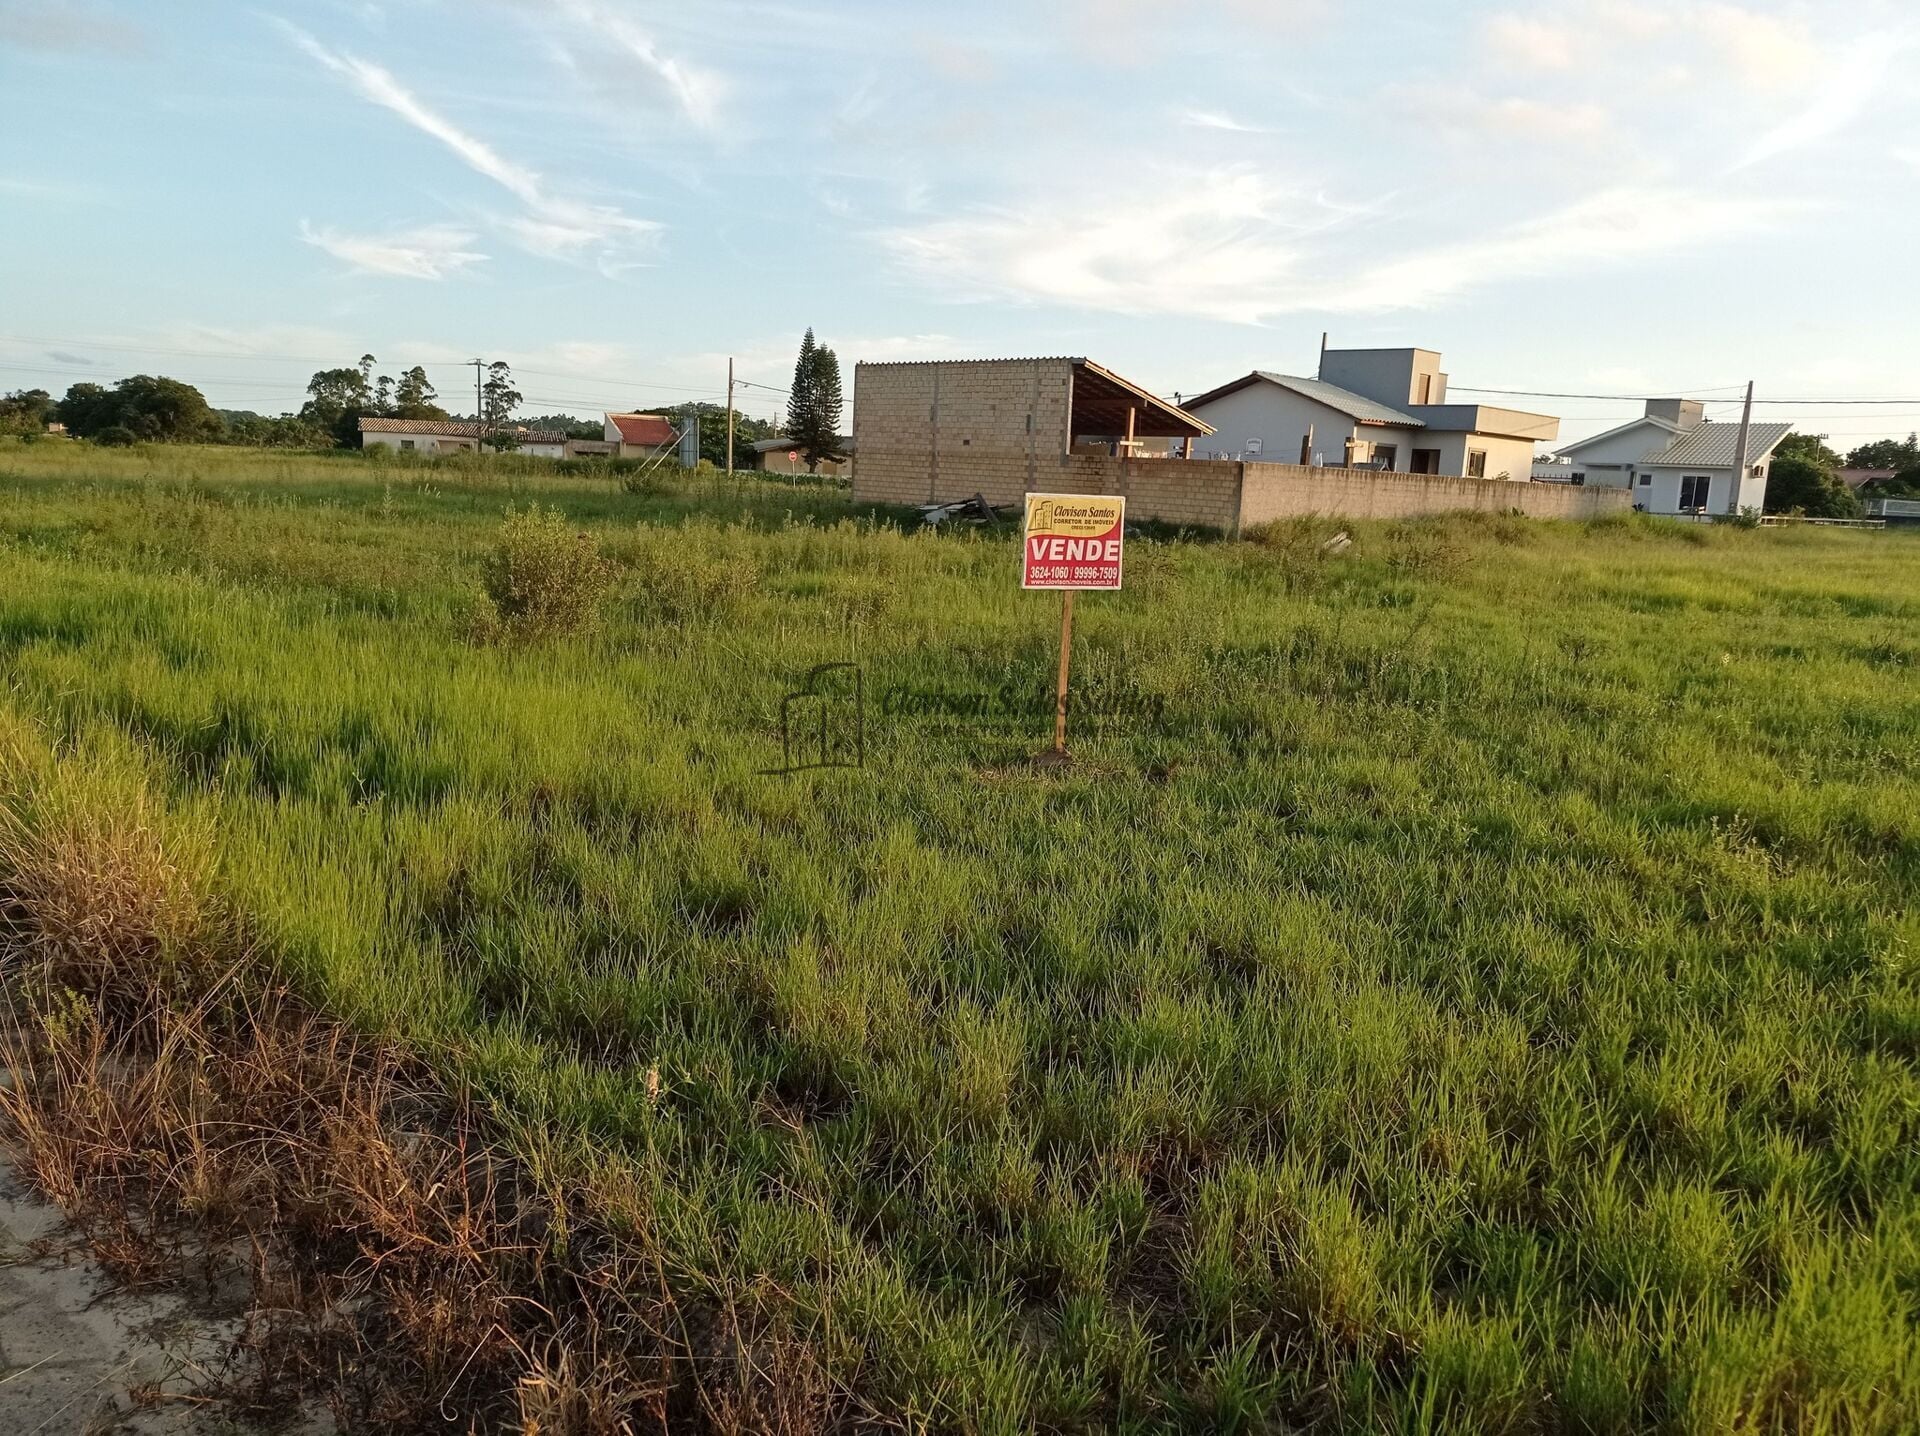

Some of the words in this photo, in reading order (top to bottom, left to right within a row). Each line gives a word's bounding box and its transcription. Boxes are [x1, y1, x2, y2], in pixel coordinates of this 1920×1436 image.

[1054, 505, 1087, 517] Clovison
[1088, 506, 1115, 518] Santos
[1031, 538, 1120, 562] VENDE
[1030, 566, 1069, 579] 3624-1060
[1074, 566, 1118, 579] 99996-7509
